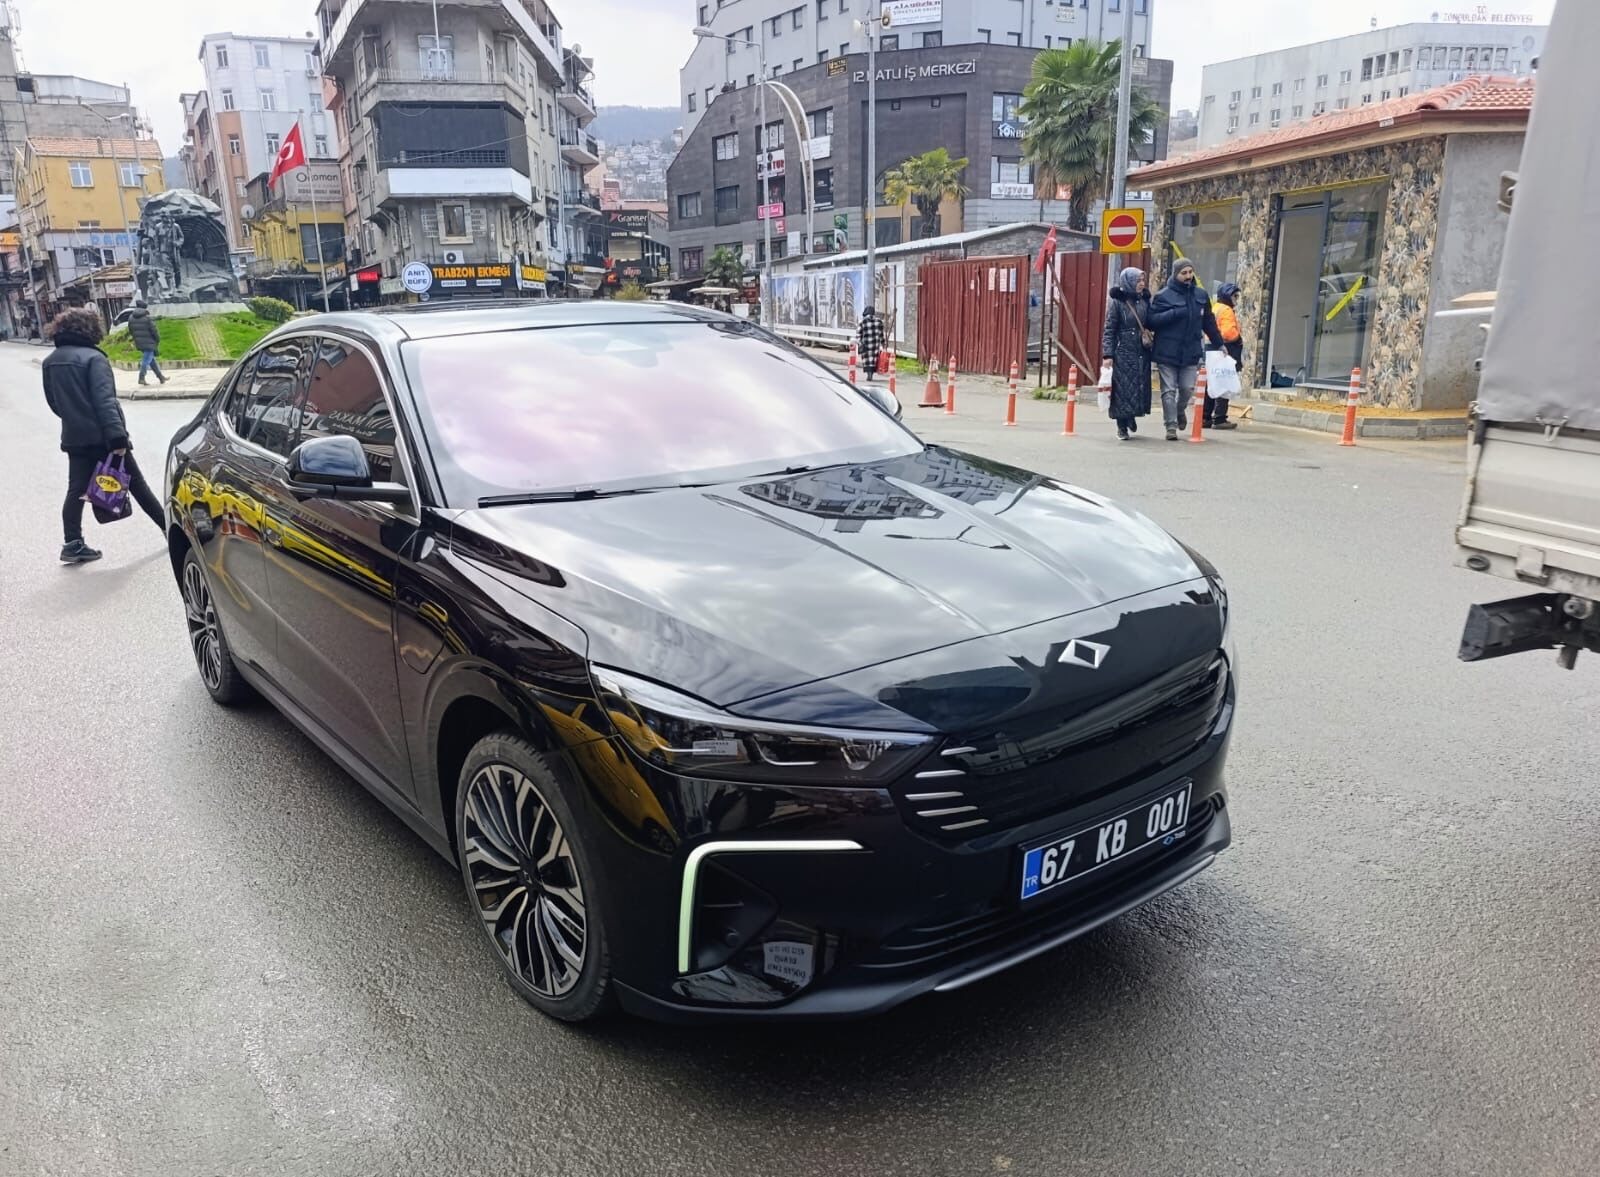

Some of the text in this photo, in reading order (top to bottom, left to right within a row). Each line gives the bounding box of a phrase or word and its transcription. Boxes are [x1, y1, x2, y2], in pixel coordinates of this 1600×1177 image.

[853, 71, 864, 83] 12
[904, 64, 916, 81] İŞ
[919, 59, 976, 77] MERKEZİ
[432, 267, 475, 279] TRABZON
[477, 265, 511, 278] EKMEĞİ
[1040, 790, 1186, 885] 67 KB 001
[1025, 875, 1039, 888] TR
